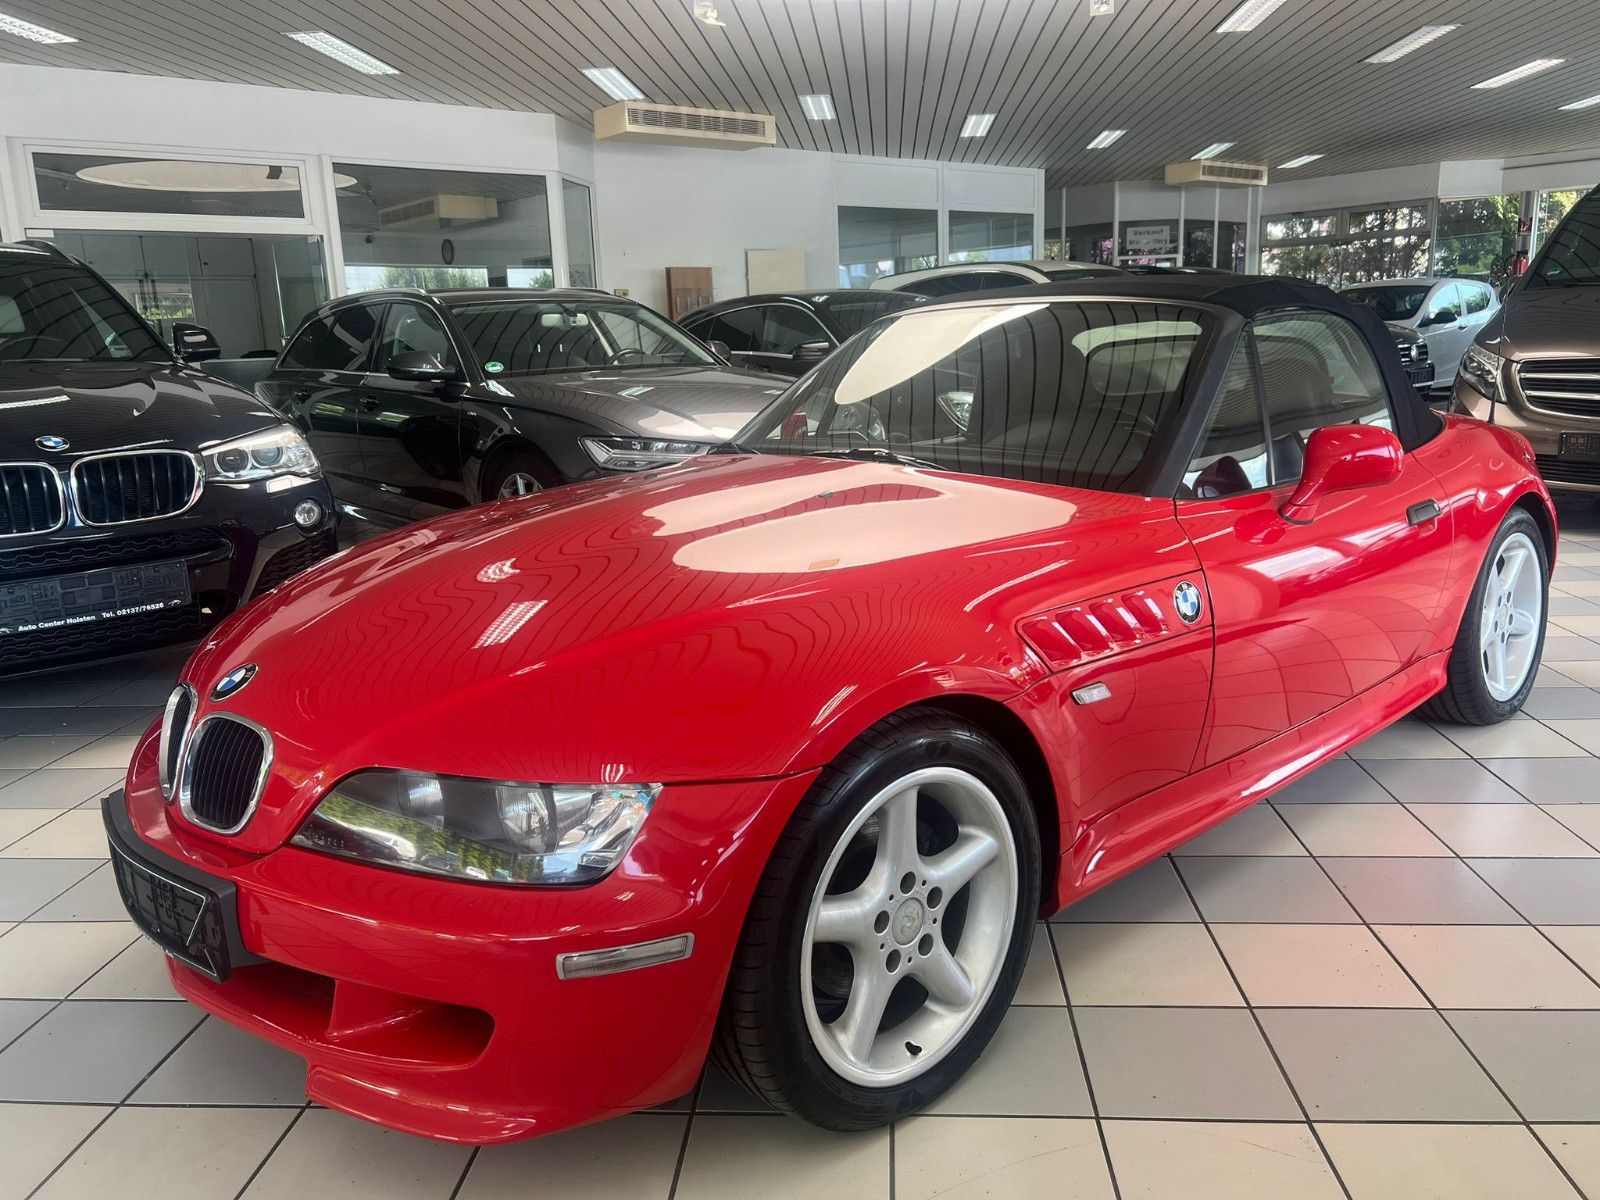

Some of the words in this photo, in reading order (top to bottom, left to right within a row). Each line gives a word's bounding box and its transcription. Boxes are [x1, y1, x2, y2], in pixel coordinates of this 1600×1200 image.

[18, 624, 37, 632] Auto
[38, 620, 65, 629] Center
[101, 611, 116, 619] Tel.
